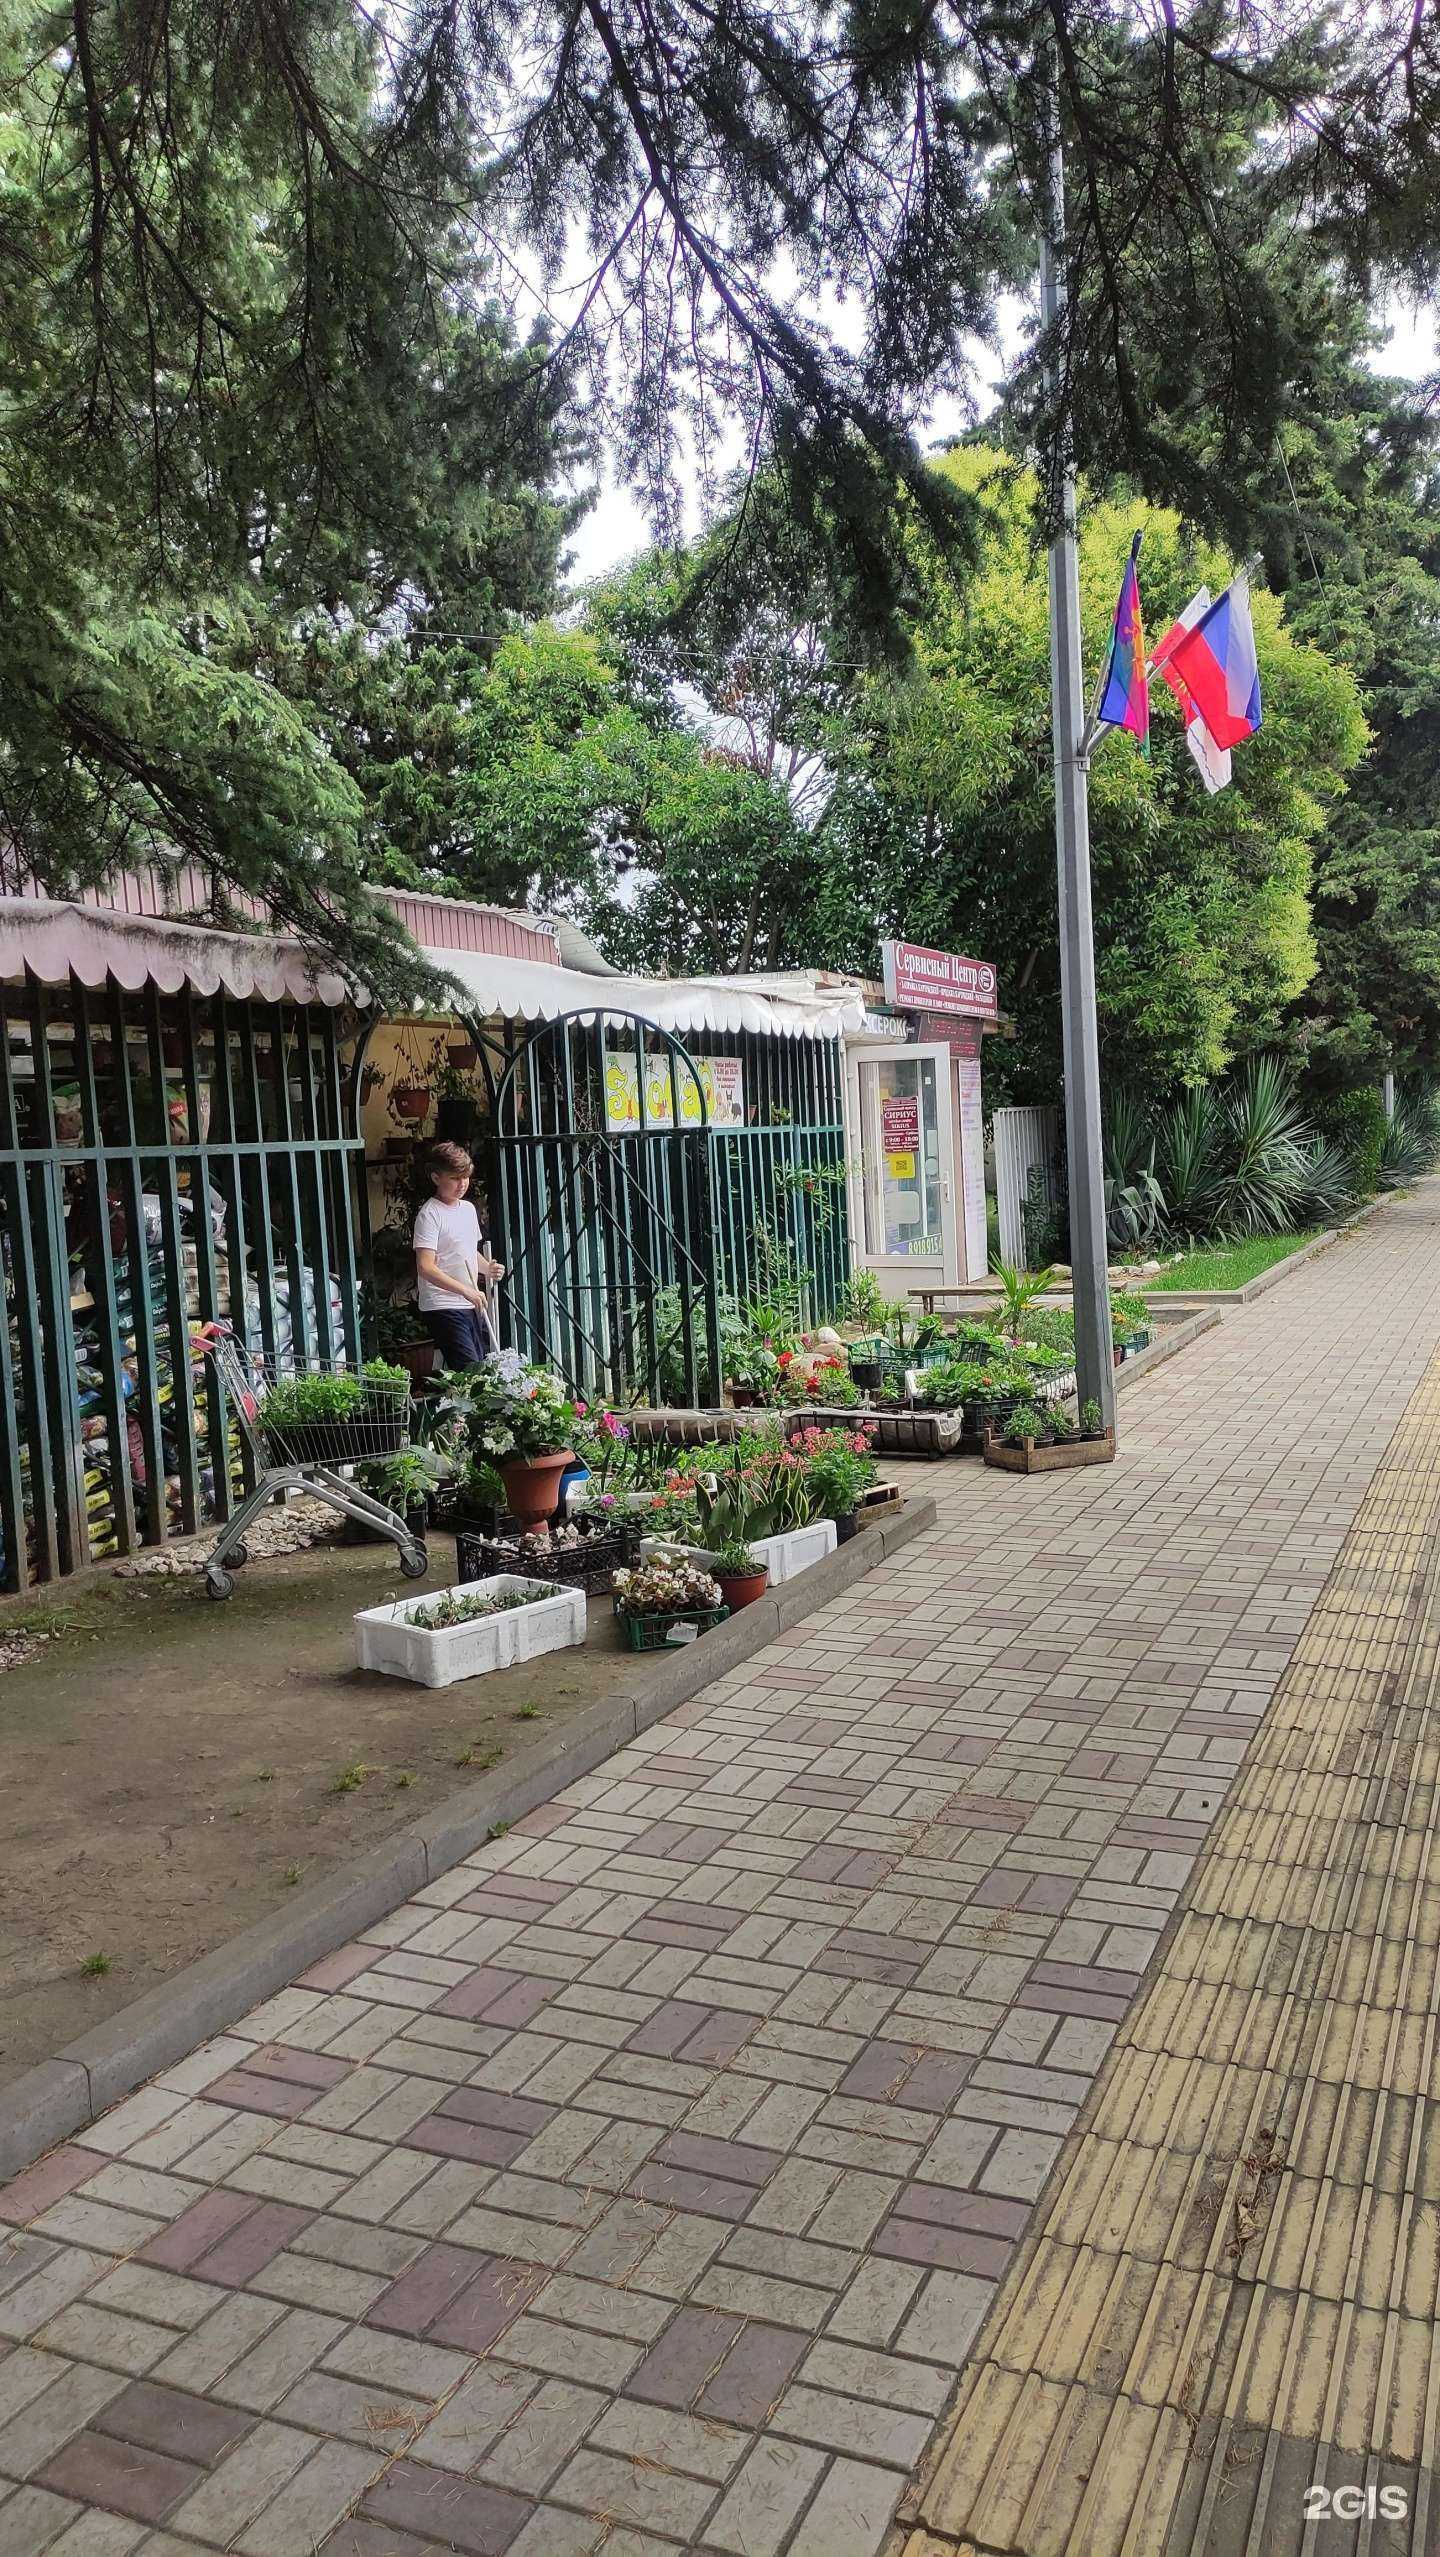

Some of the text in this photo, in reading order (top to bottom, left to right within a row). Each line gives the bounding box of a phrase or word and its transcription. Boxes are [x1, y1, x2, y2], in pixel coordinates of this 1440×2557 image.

[895, 944, 978, 991] Сервисный Центр
[884, 1111, 917, 1119] СИРИУС
